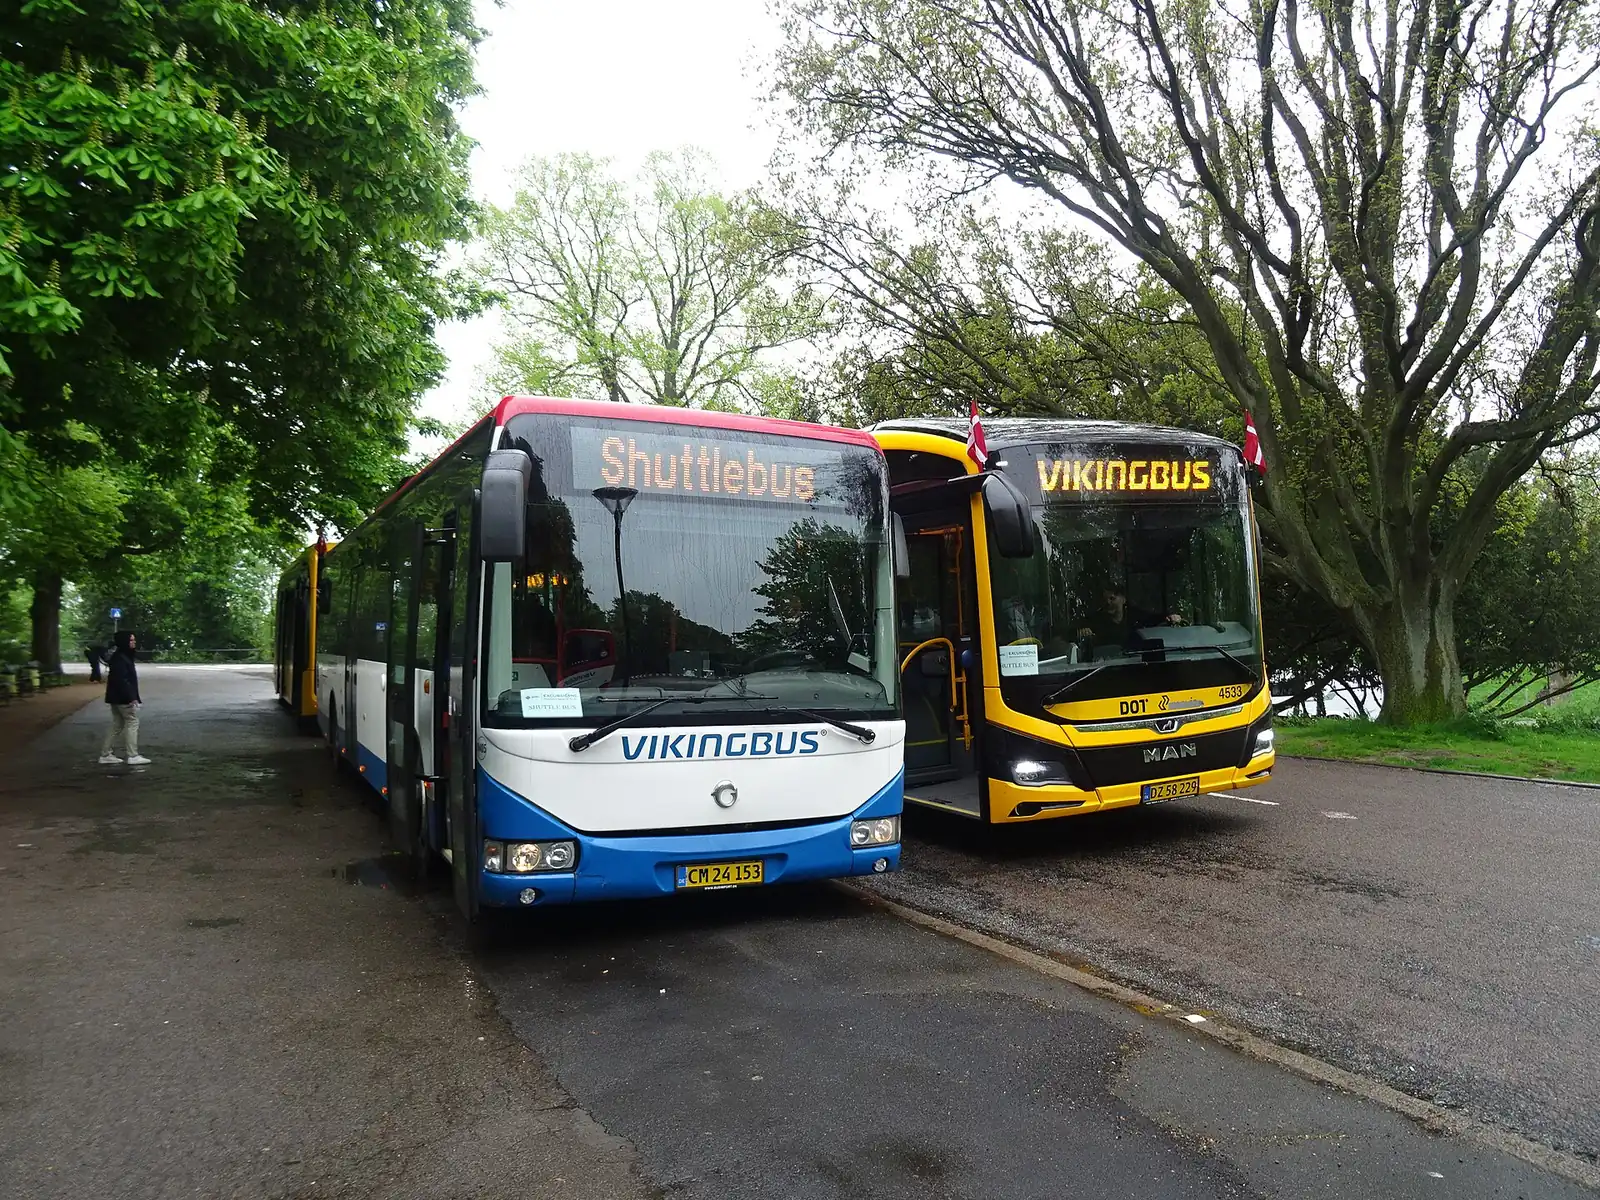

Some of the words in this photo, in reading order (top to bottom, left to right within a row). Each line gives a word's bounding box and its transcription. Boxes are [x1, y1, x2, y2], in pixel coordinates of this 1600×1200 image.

[601, 436, 814, 499] Shuttlebus
[1037, 460, 1211, 491] VIKINGBUS
[1218, 685, 1243, 699] 4533
[1119, 698, 1148, 716] DOT
[1143, 742, 1197, 763] MAN
[1151, 786, 1164, 799] DZ
[1166, 784, 1178, 797] 58
[1180, 781, 1197, 794] 229
[688, 868, 709, 884] CM
[712, 866, 731, 882] 24
[735, 864, 761, 881] 153
